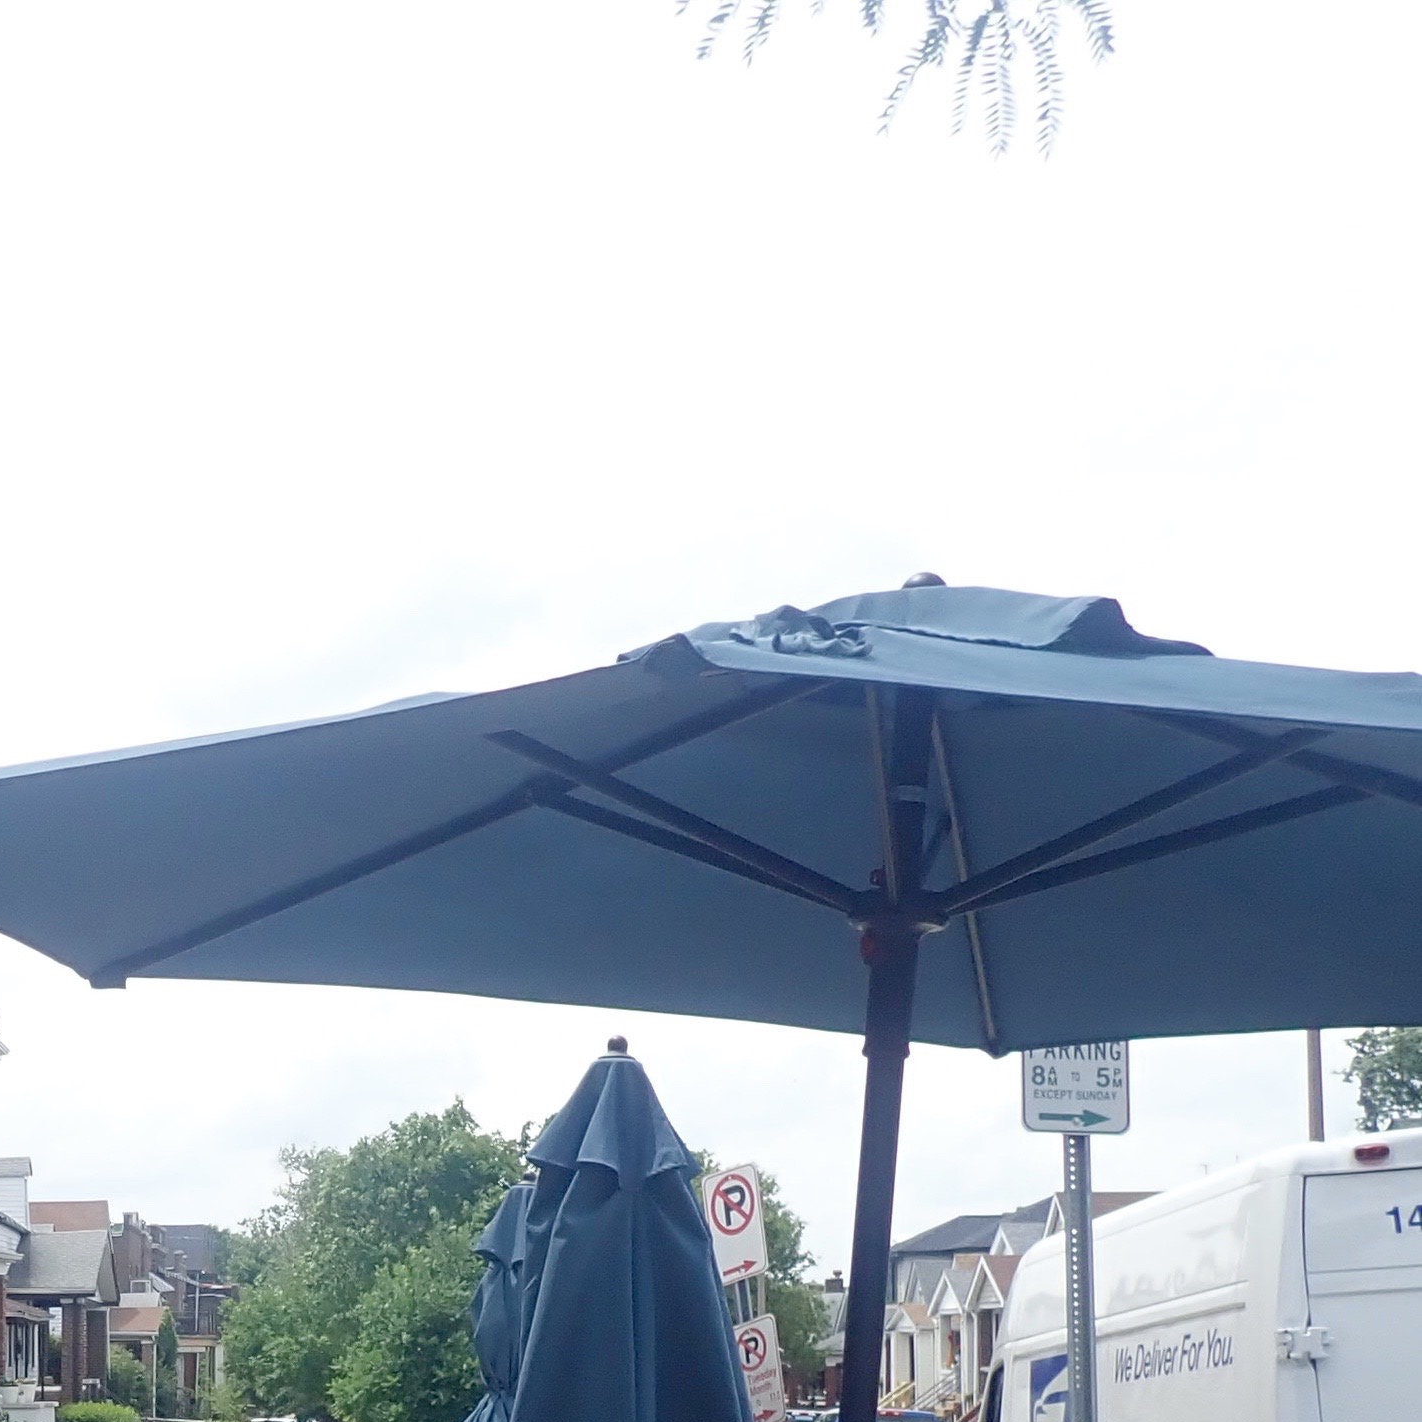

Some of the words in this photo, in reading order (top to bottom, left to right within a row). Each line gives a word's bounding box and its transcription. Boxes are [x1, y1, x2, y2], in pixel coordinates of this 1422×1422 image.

[1070, 1072, 1080, 1082] TO
[1033, 1089, 1073, 1100] EXCEPT
[1076, 1090, 1118, 1101] SUNDAY
[1386, 1205, 1422, 1234] 14
[1115, 1347, 1133, 1383] We
[1134, 1340, 1179, 1380] Deliver
[1179, 1333, 1204, 1373] For
[1206, 1328, 1233, 1368] You.
